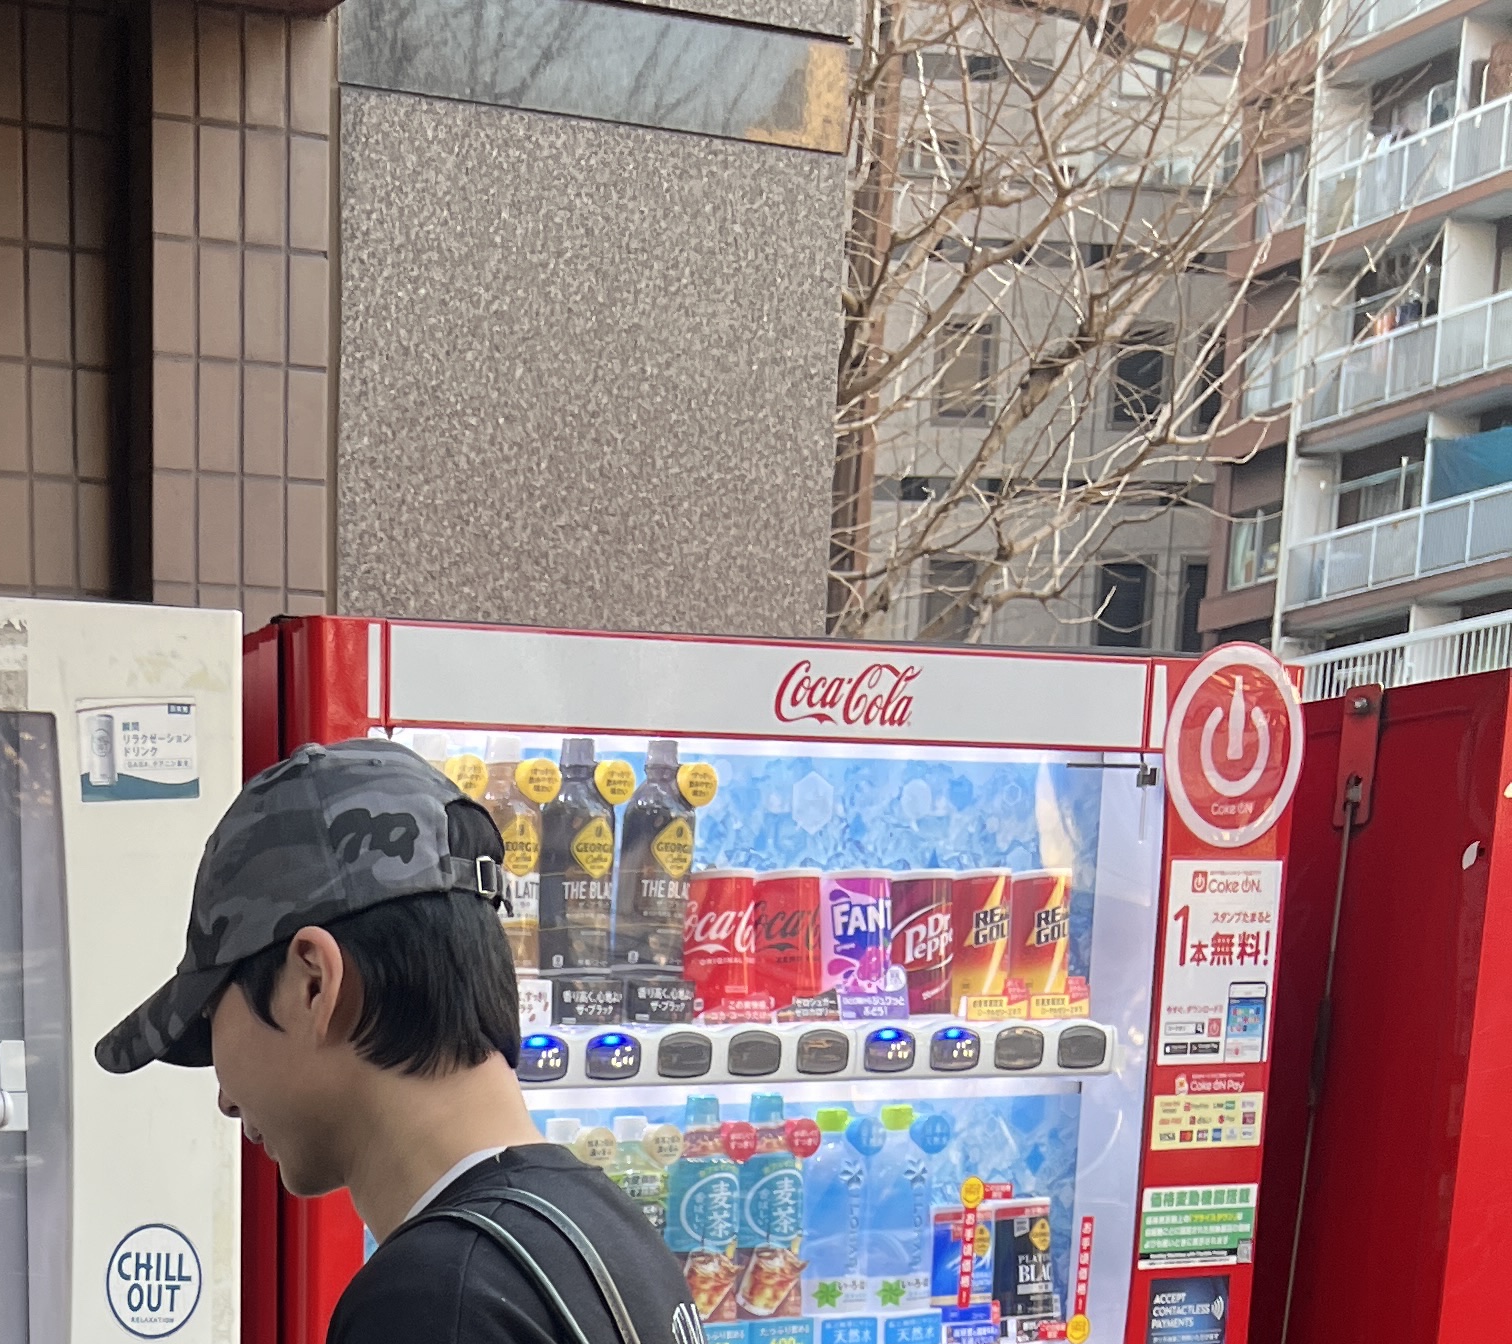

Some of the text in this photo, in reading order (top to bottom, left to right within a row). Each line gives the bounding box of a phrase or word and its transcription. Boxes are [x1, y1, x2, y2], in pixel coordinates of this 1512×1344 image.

[774, 660, 924, 727] Coca-Cola
[123, 733, 192, 744] リラクゼーション
[124, 746, 159, 758] ドリンク
[1210, 802, 1236, 816] Coke
[562, 881, 586, 901] THE
[641, 879, 666, 898] THE
[1208, 878, 1239, 894] Coke
[1211, 911, 1272, 924] スタンプたまると
[707, 1180, 732, 1239] 麦茶
[772, 1176, 797, 1234] 麦茶
[117, 1252, 192, 1282] CHILL
[128, 1283, 181, 1312] OUT
[1153, 1292, 1187, 1305] ACCEPT
[1152, 1303, 1211, 1317] CONTACTLESS
[1151, 1316, 1195, 1330] PAYMENTS
